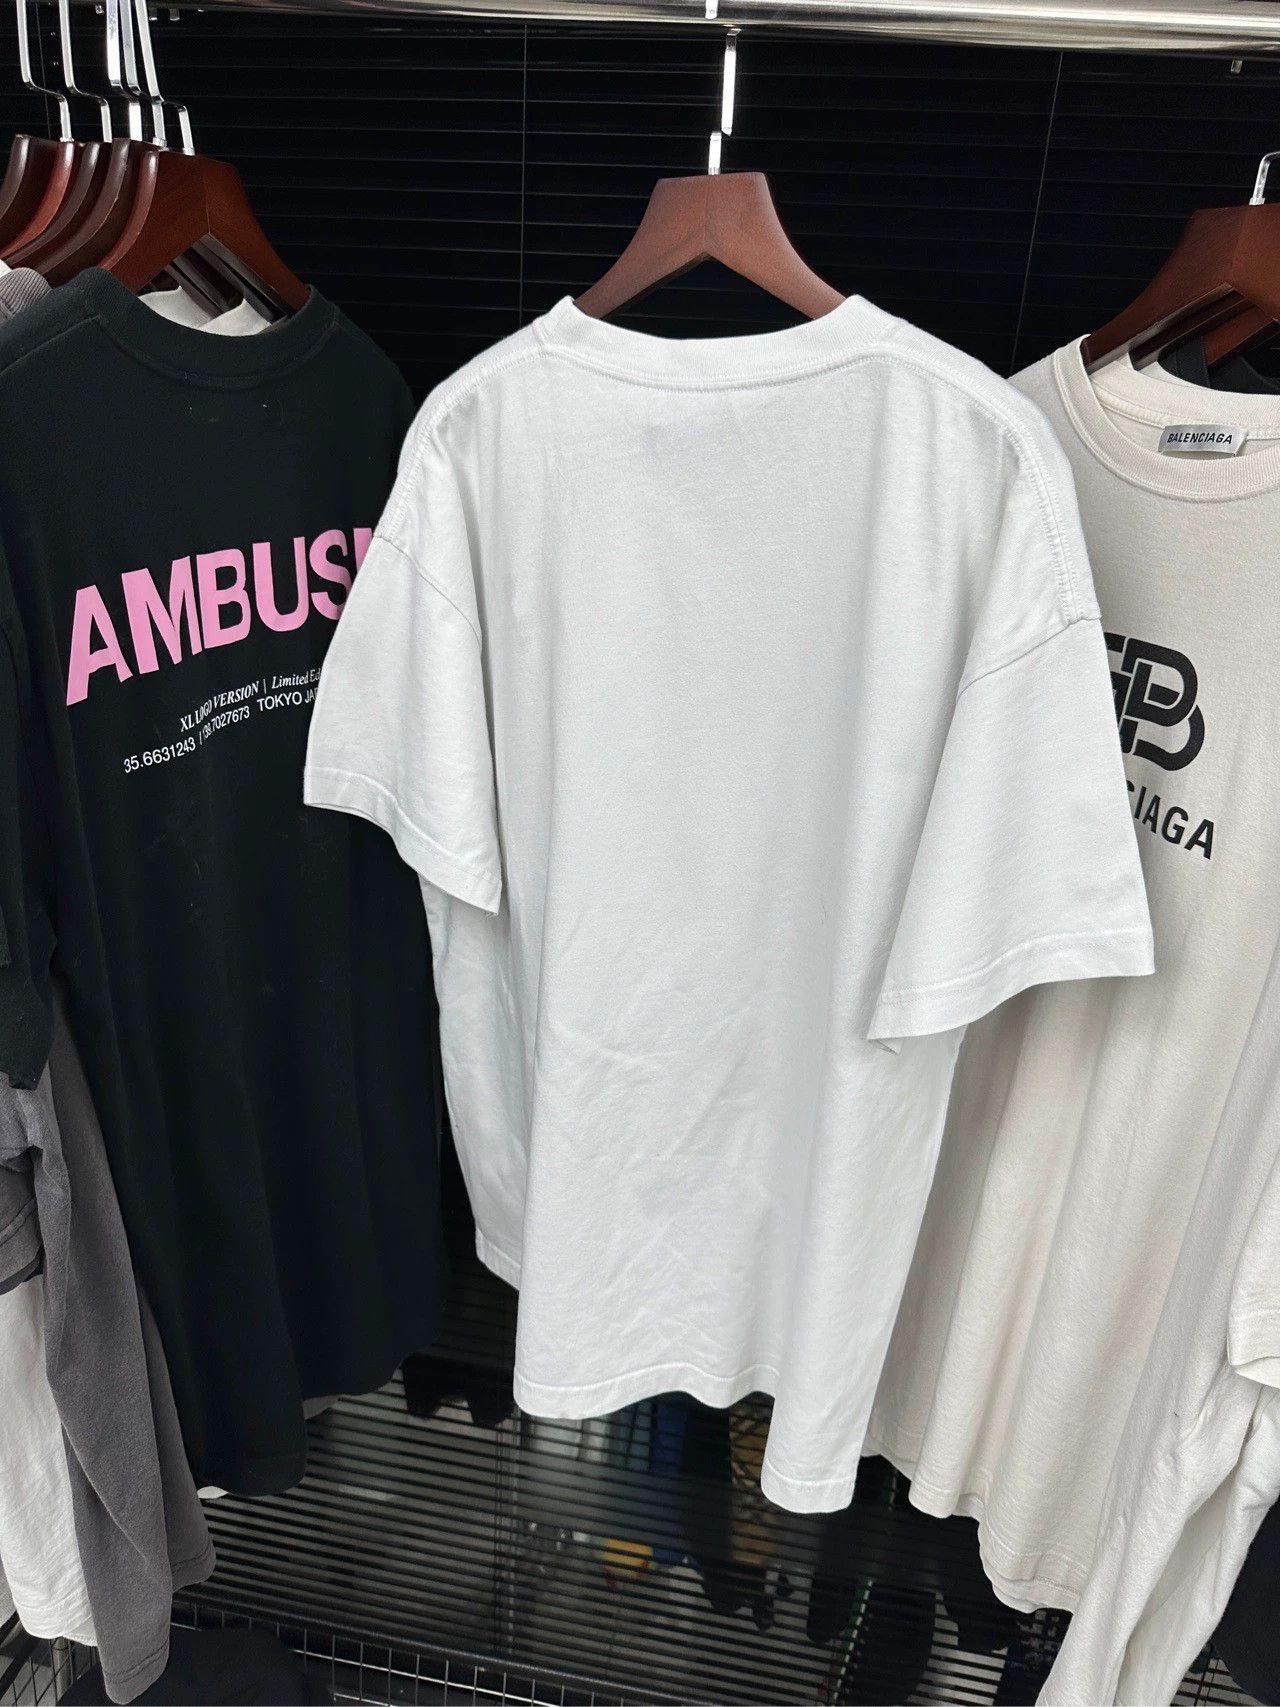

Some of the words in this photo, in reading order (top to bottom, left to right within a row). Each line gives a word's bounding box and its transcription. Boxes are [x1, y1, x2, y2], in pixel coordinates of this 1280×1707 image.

[1167, 432, 1233, 444] BALENCIAGA
[123, 736, 196, 773] 35.6631243
[256, 691, 303, 711] TOKYO
[180, 714, 195, 732] XL
[213, 681, 260, 709] VERSION
[271, 670, 309, 689] Limited
[1125, 779, 1215, 860] IAGA
